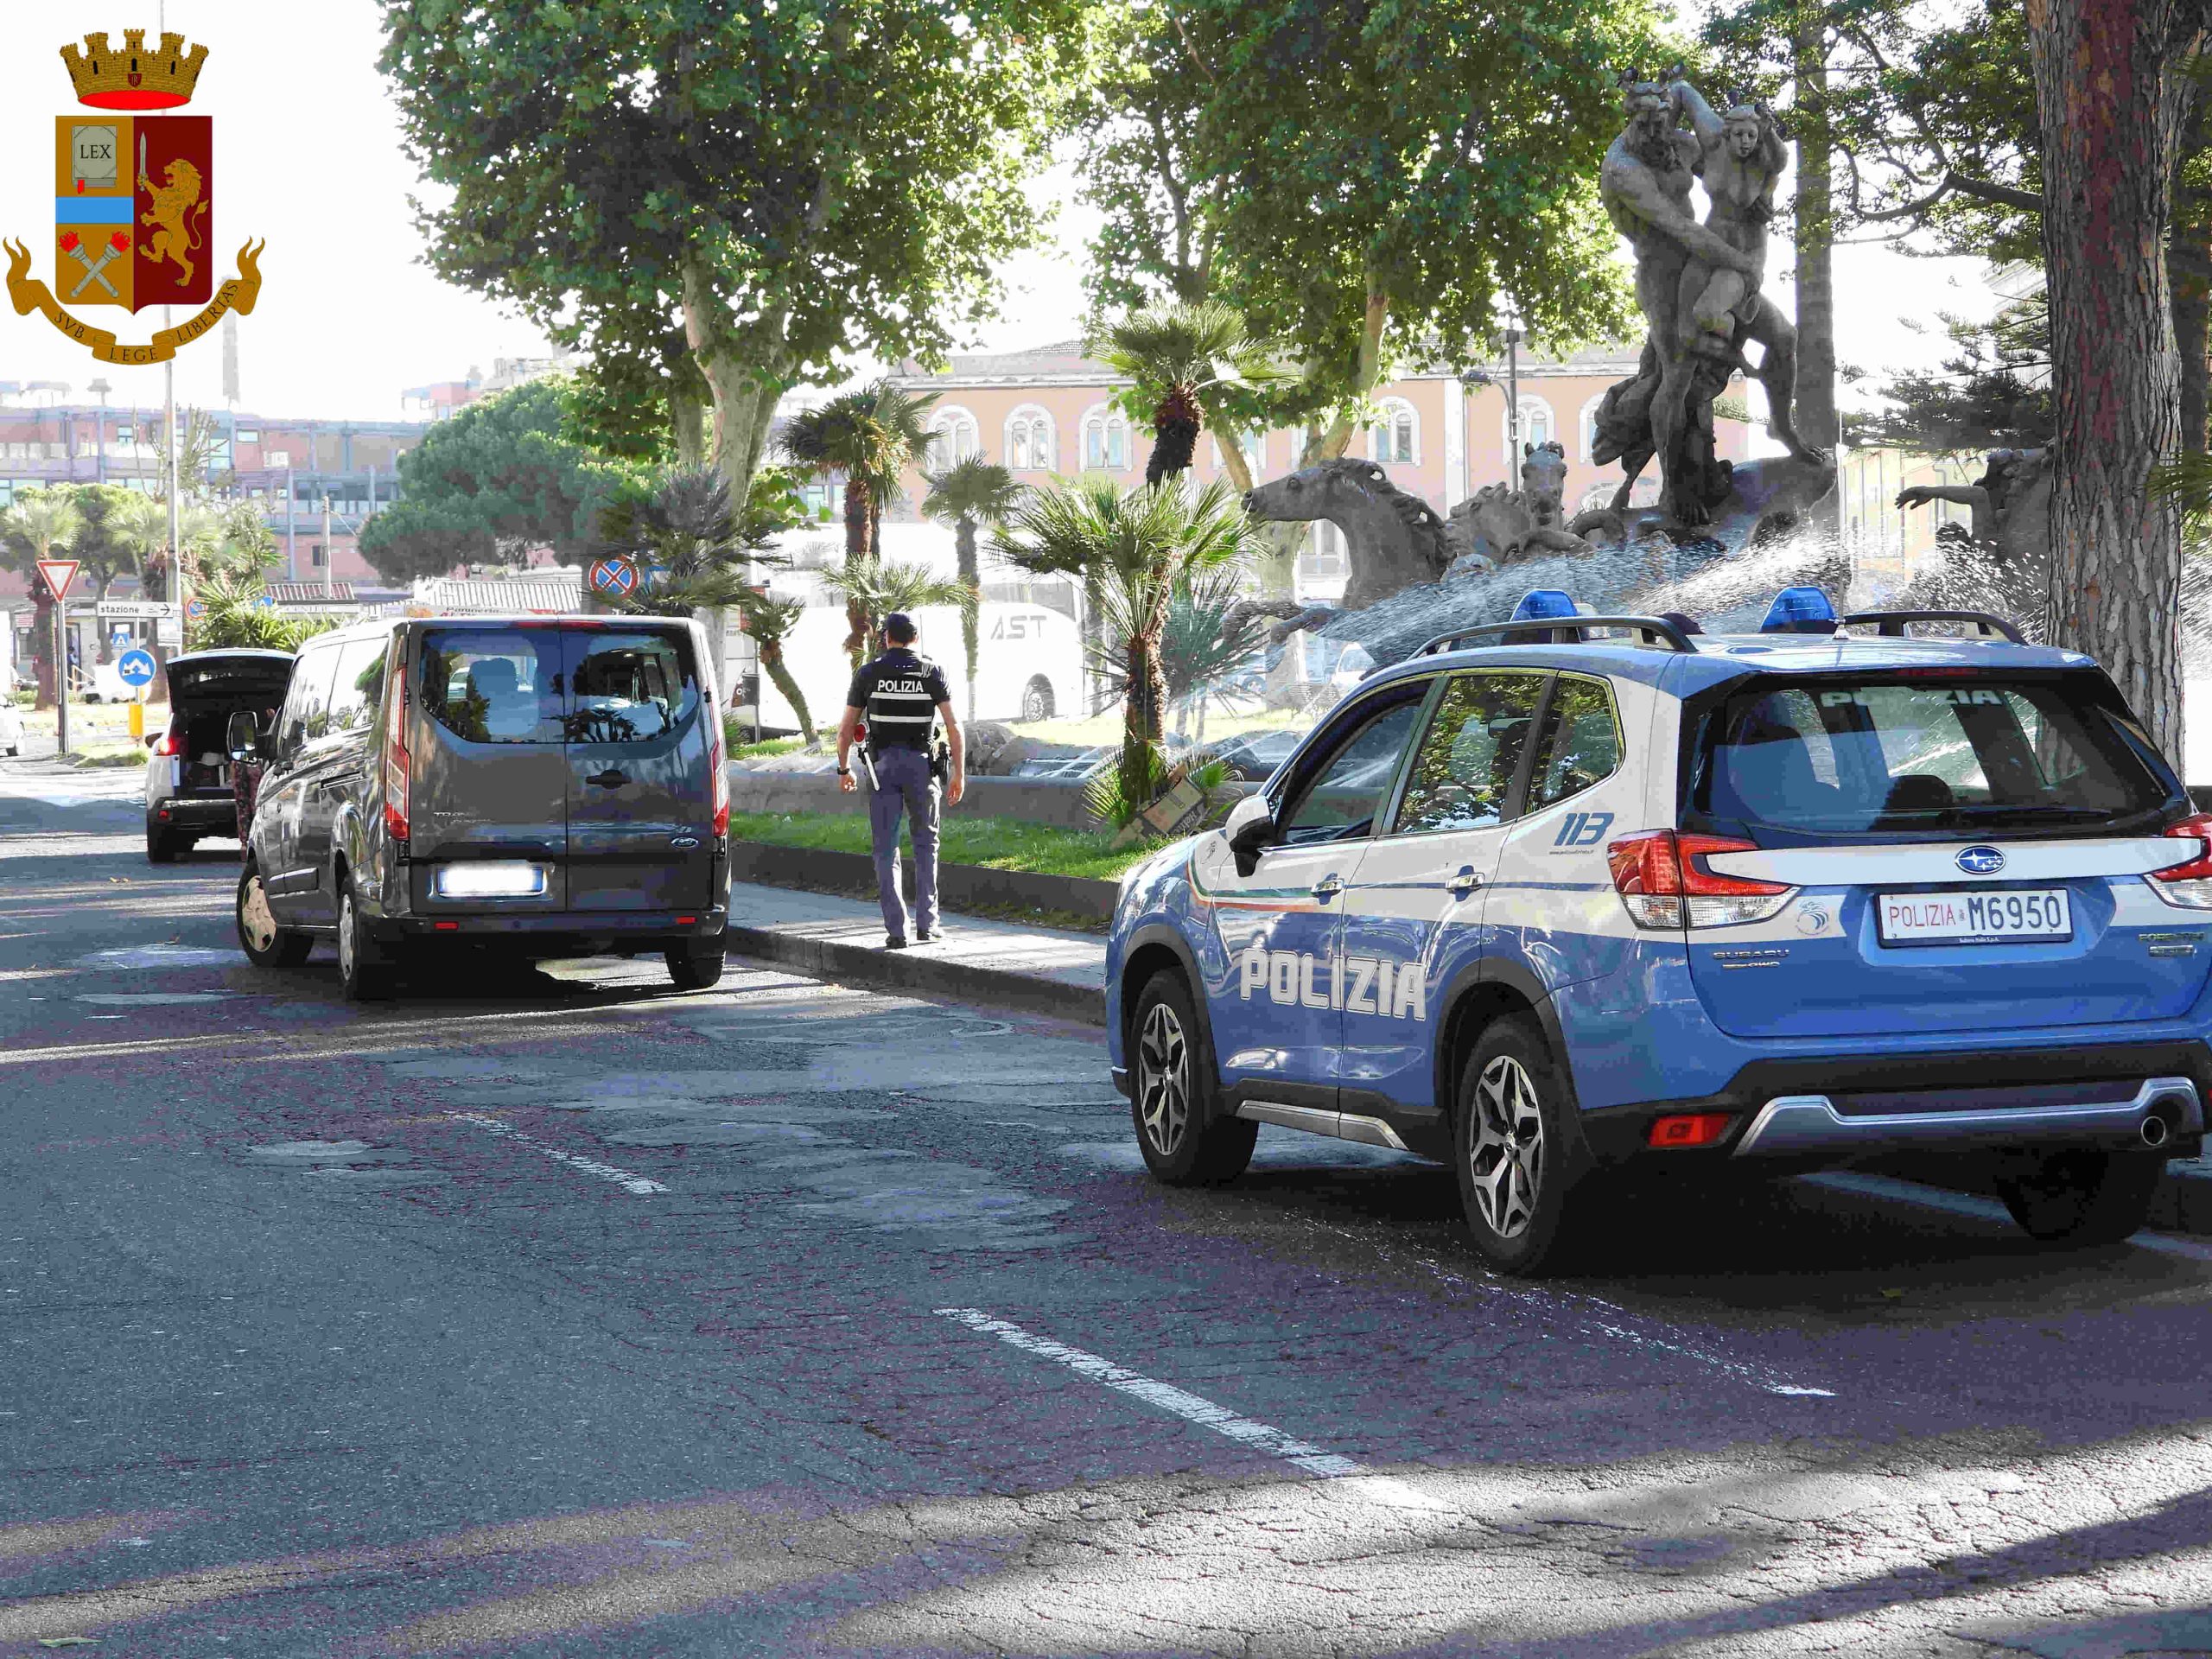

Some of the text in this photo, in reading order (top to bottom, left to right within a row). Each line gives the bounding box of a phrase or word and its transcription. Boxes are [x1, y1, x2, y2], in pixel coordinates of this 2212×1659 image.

[100, 605, 140, 613] stazione
[990, 615, 1047, 639] AST
[878, 680, 924, 693] POLIZIA
[1554, 812, 1615, 847] 113
[1889, 904, 1956, 927] POLIZIA
[1967, 896, 2062, 931] M6950
[1713, 949, 1789, 959] SUBARU
[1240, 948, 1426, 1021] POLIZIA
